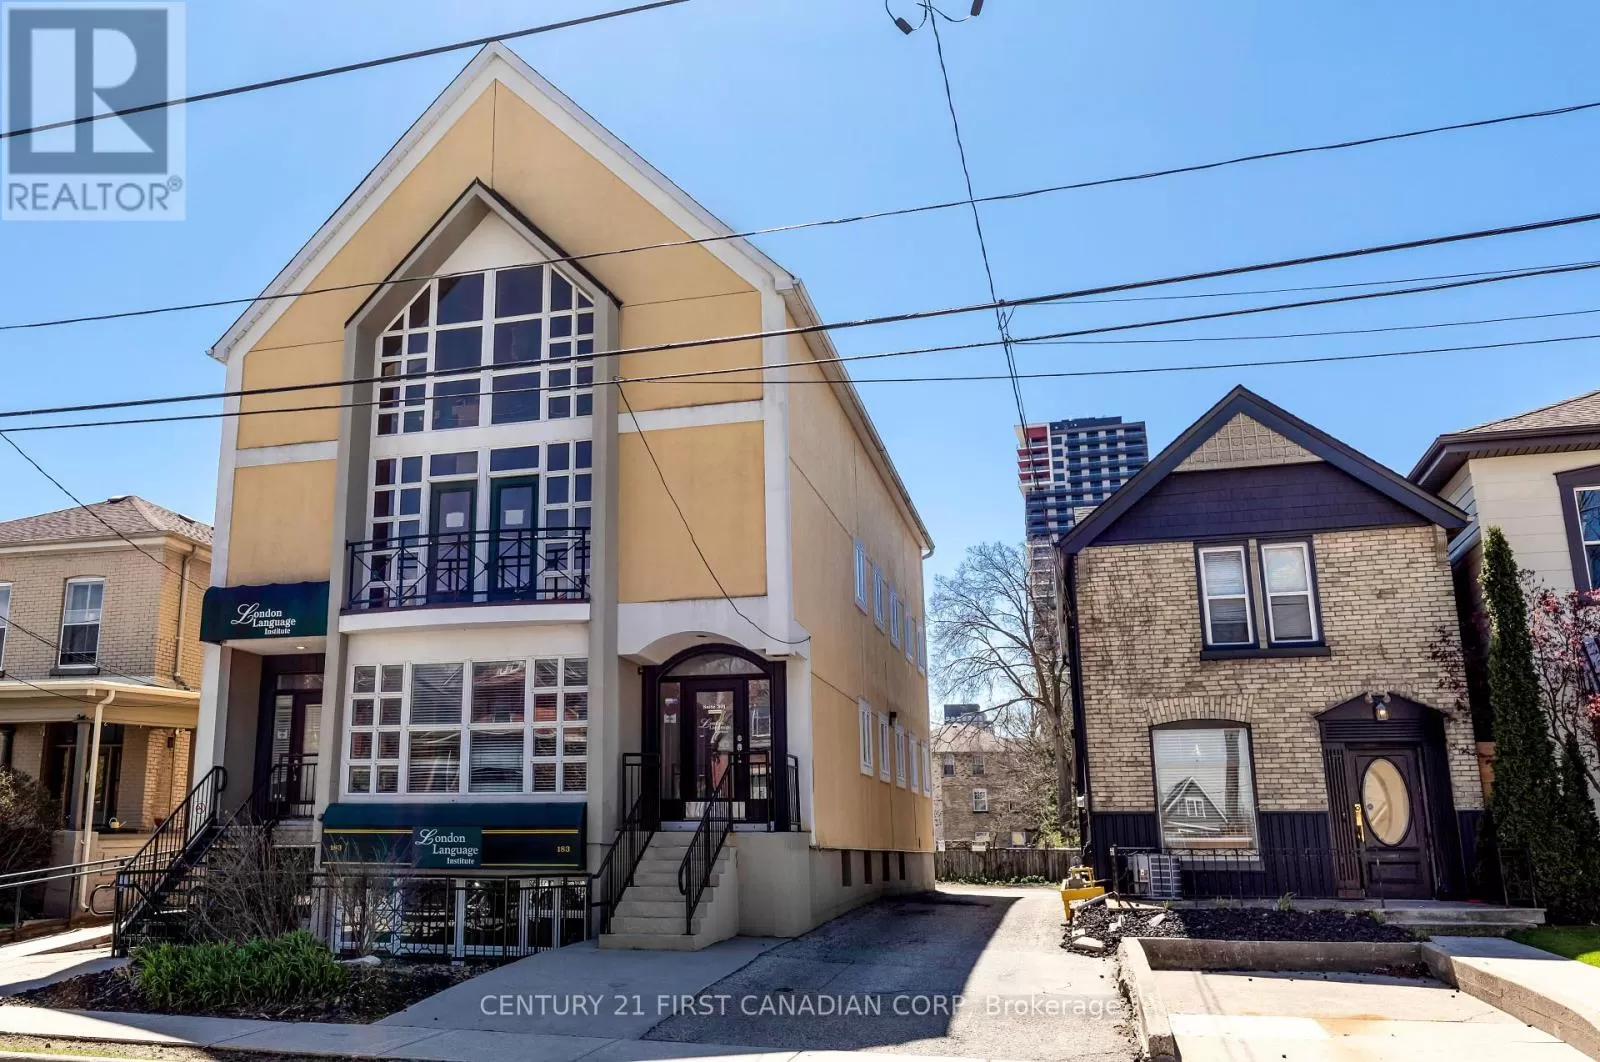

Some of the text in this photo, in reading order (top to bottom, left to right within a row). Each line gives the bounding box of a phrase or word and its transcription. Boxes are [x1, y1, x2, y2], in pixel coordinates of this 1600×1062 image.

[230, 602, 282, 625] London
[252, 617, 297, 628] Language
[414, 828, 466, 846] London
[432, 844, 480, 857] Language
[556, 845, 571, 853] 183
[446, 856, 475, 865] Institute
